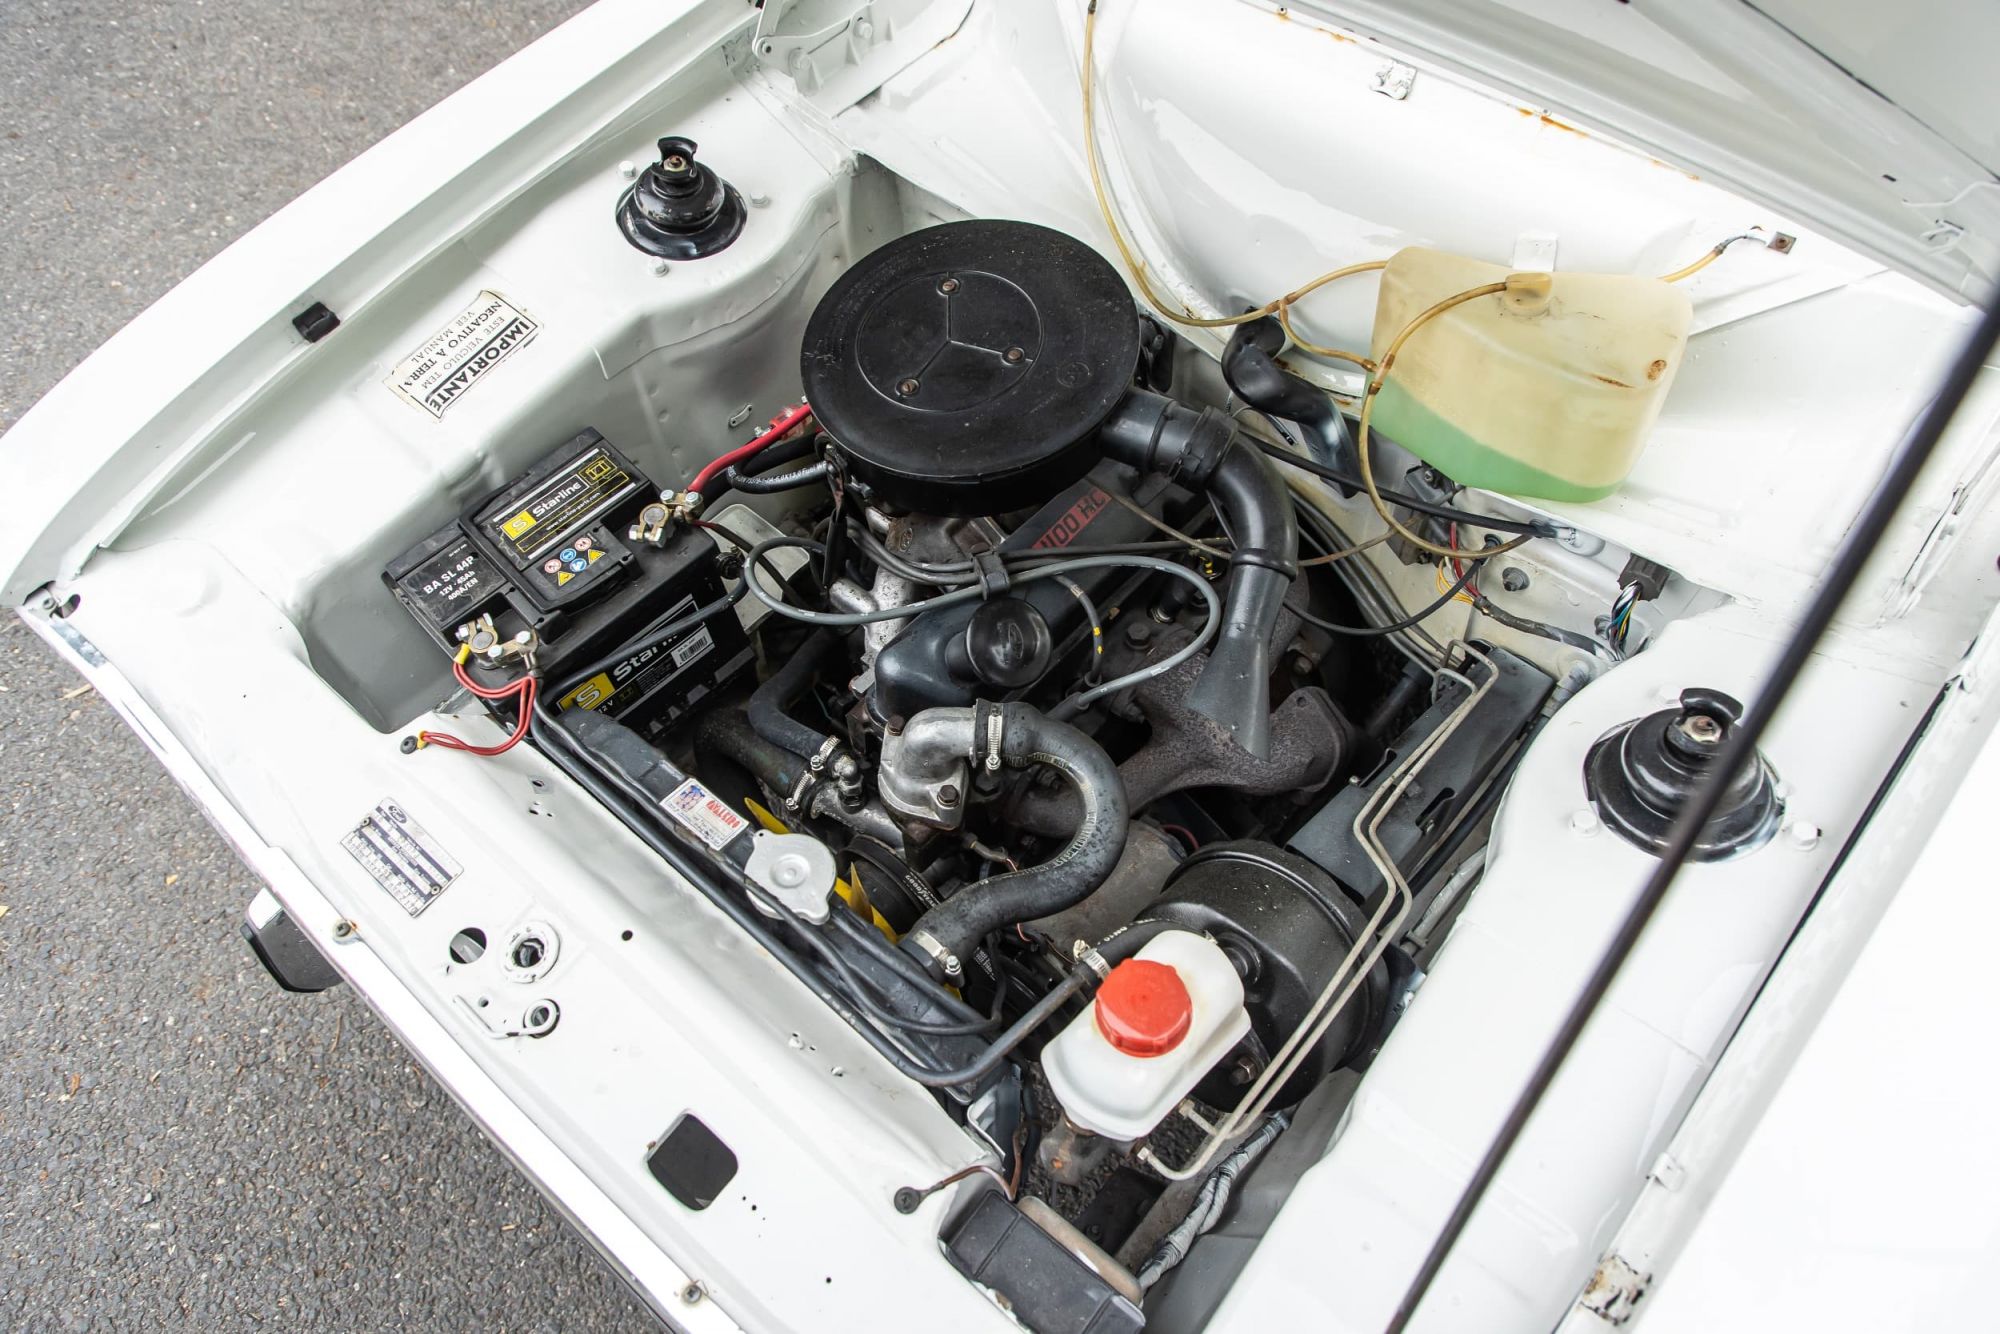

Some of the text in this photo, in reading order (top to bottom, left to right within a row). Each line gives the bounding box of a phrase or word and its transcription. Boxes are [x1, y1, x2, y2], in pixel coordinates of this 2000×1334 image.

[411, 311, 475, 363] VER MANUAL
[448, 301, 502, 348] NEGATIVO
[485, 317, 505, 336] ESTE
[404, 358, 437, 387] TERRA
[421, 371, 442, 389] TEM
[429, 320, 530, 411] IMPORTANTE
[532, 482, 581, 517] Starline
[423, 556, 474, 594] BA SL 44P
[440, 585, 453, 596] 12V
[457, 571, 476, 584] 45Ah
[448, 578, 479, 600] 400A/EN
